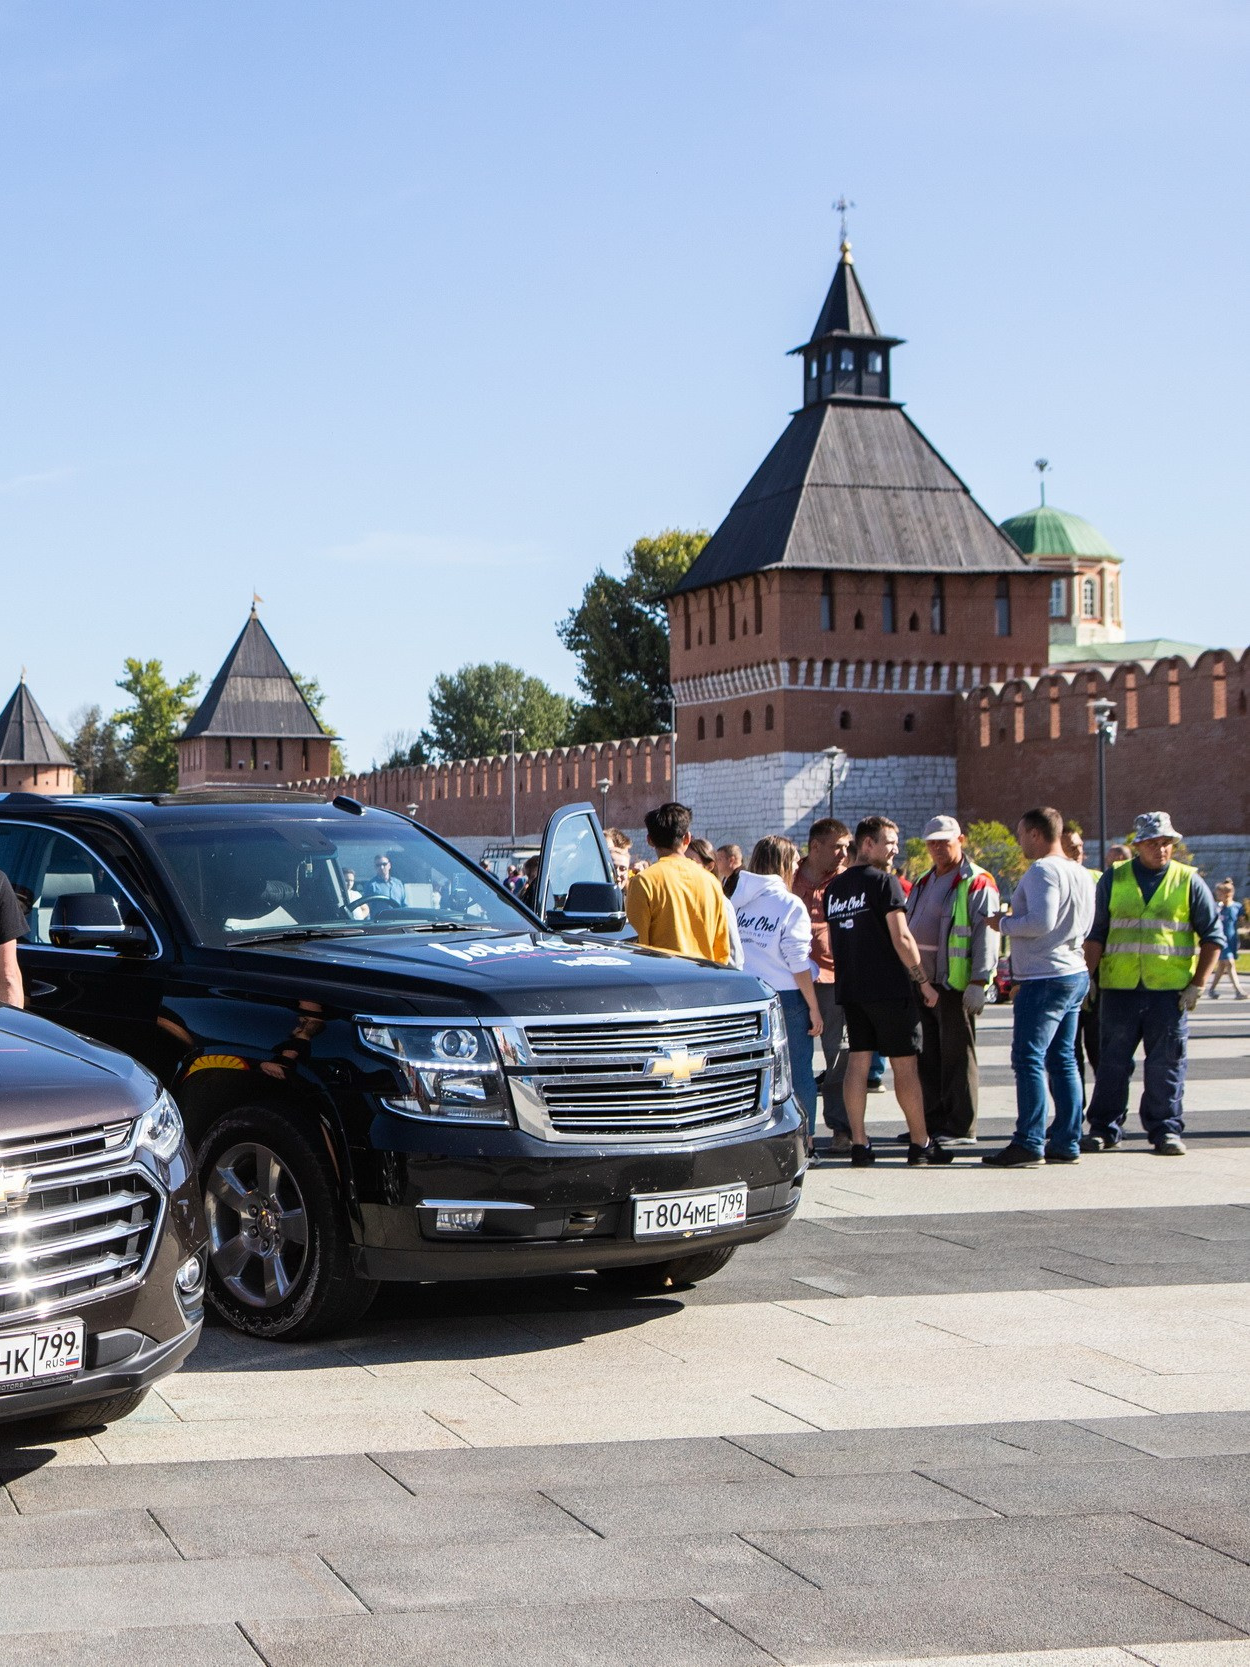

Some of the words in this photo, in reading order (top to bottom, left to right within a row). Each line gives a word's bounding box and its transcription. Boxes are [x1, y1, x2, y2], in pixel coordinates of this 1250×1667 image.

[721, 1193, 743, 1213] 799
[725, 1212, 736, 1220] RUS
[37, 1331, 77, 1361] 799
[45, 1358, 65, 1369] RUS
